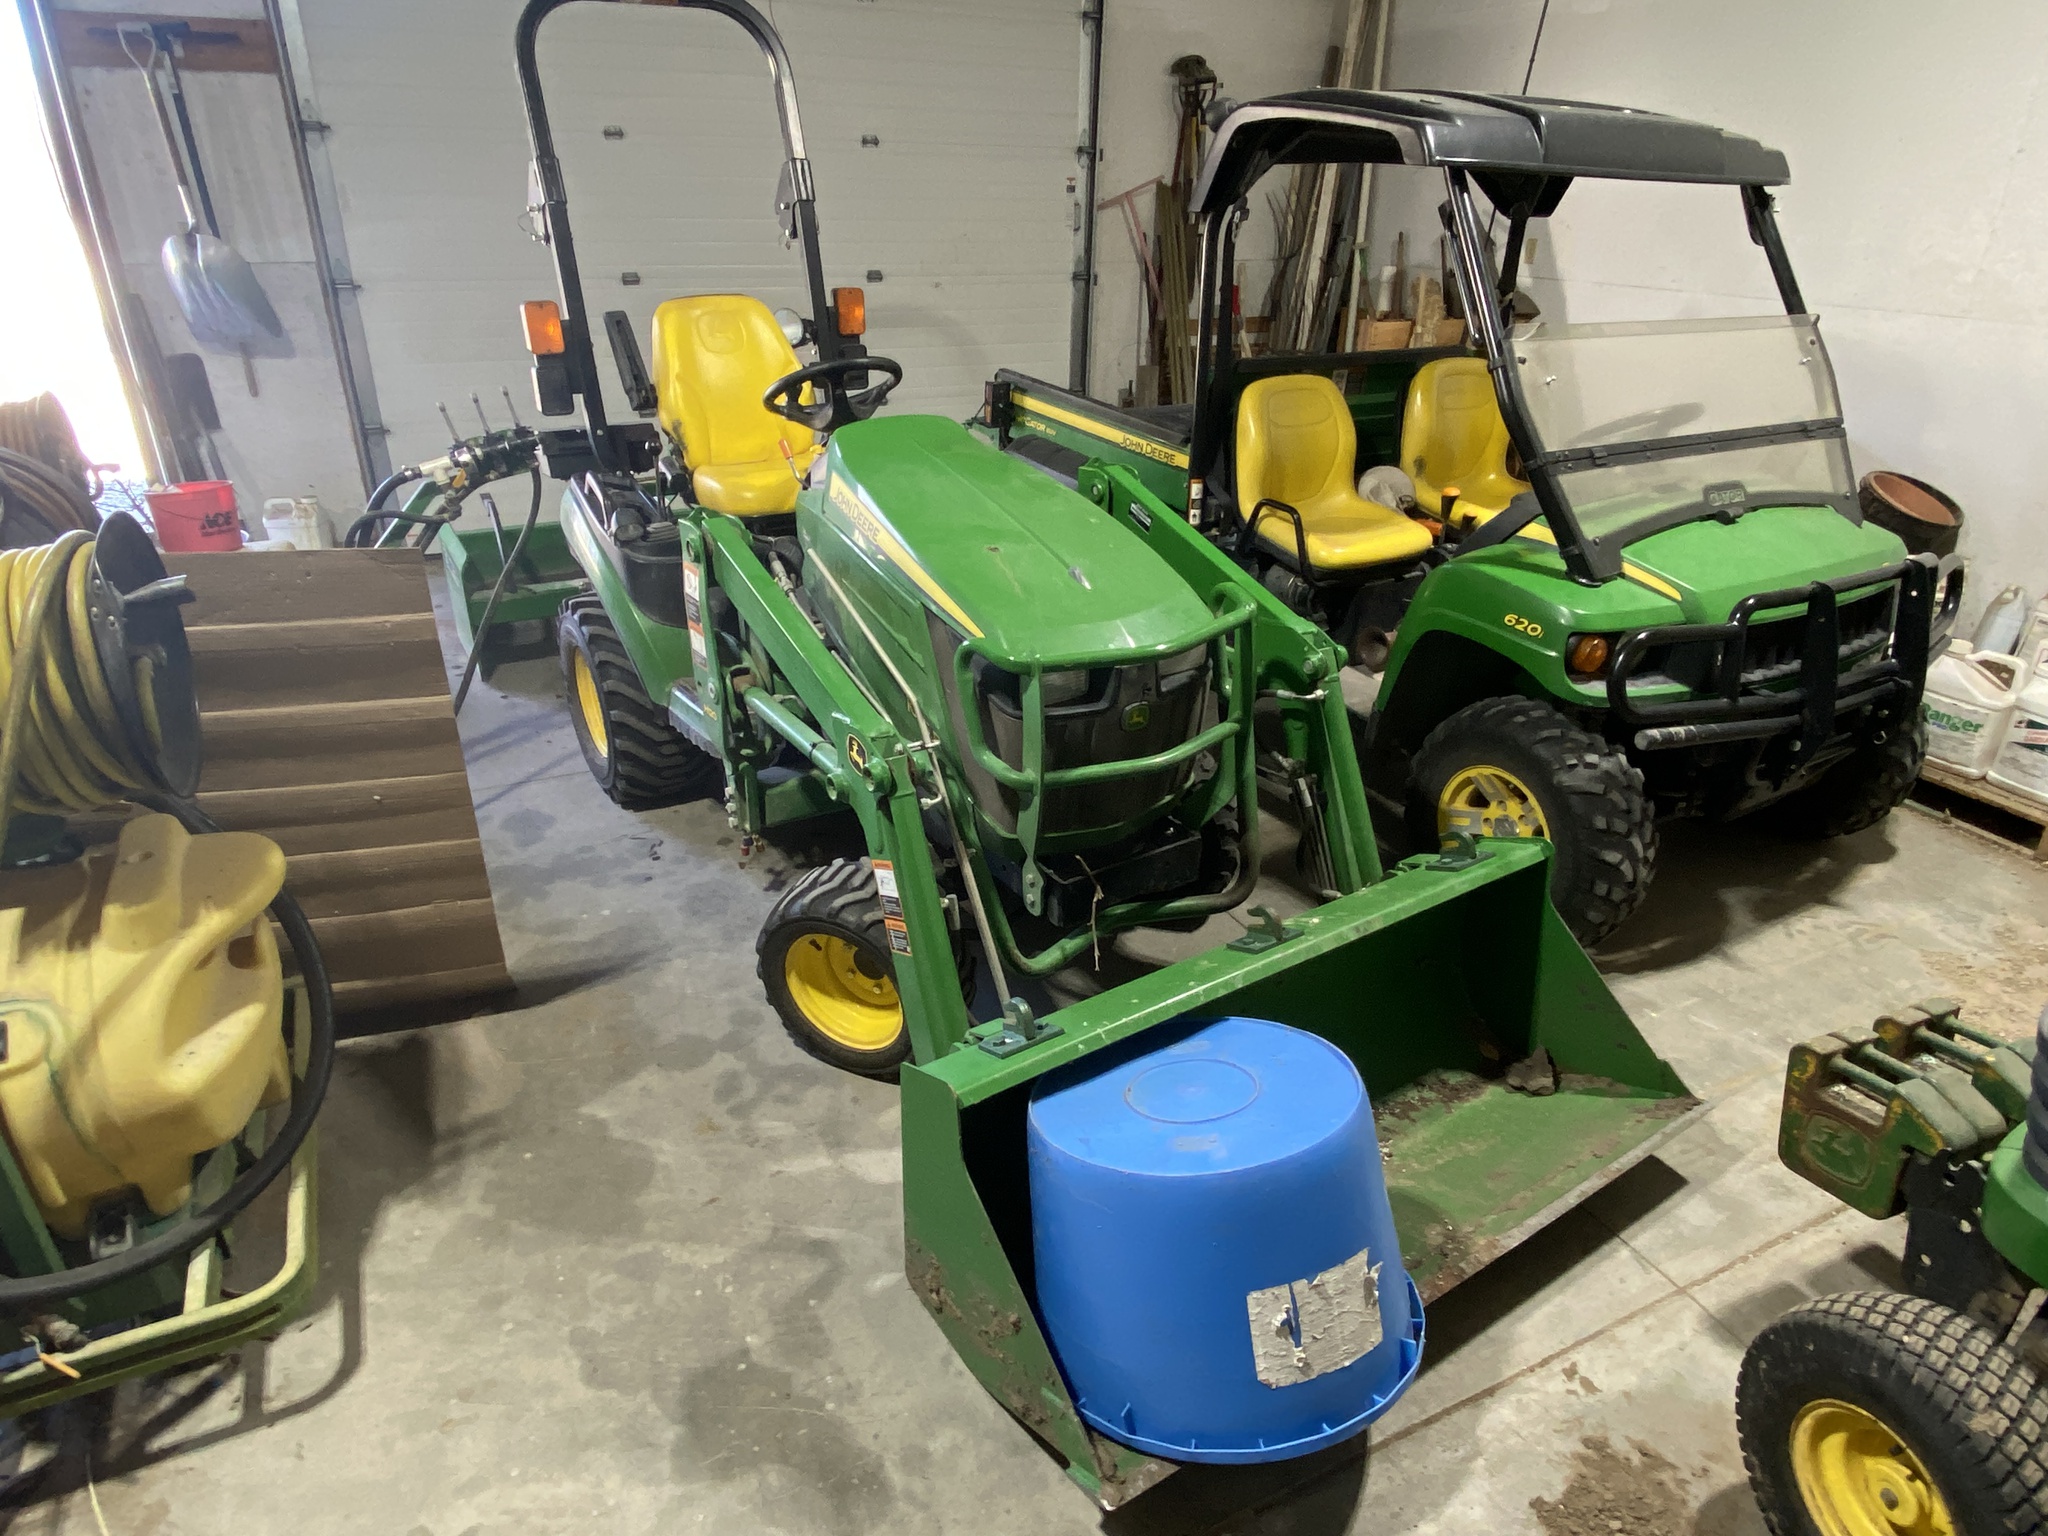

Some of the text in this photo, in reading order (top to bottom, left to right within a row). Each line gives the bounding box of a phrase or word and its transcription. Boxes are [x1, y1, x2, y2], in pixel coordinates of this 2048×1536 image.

[1119, 434, 1176, 465] JOHN DEERE
[829, 487, 880, 543] JOHN DEERE
